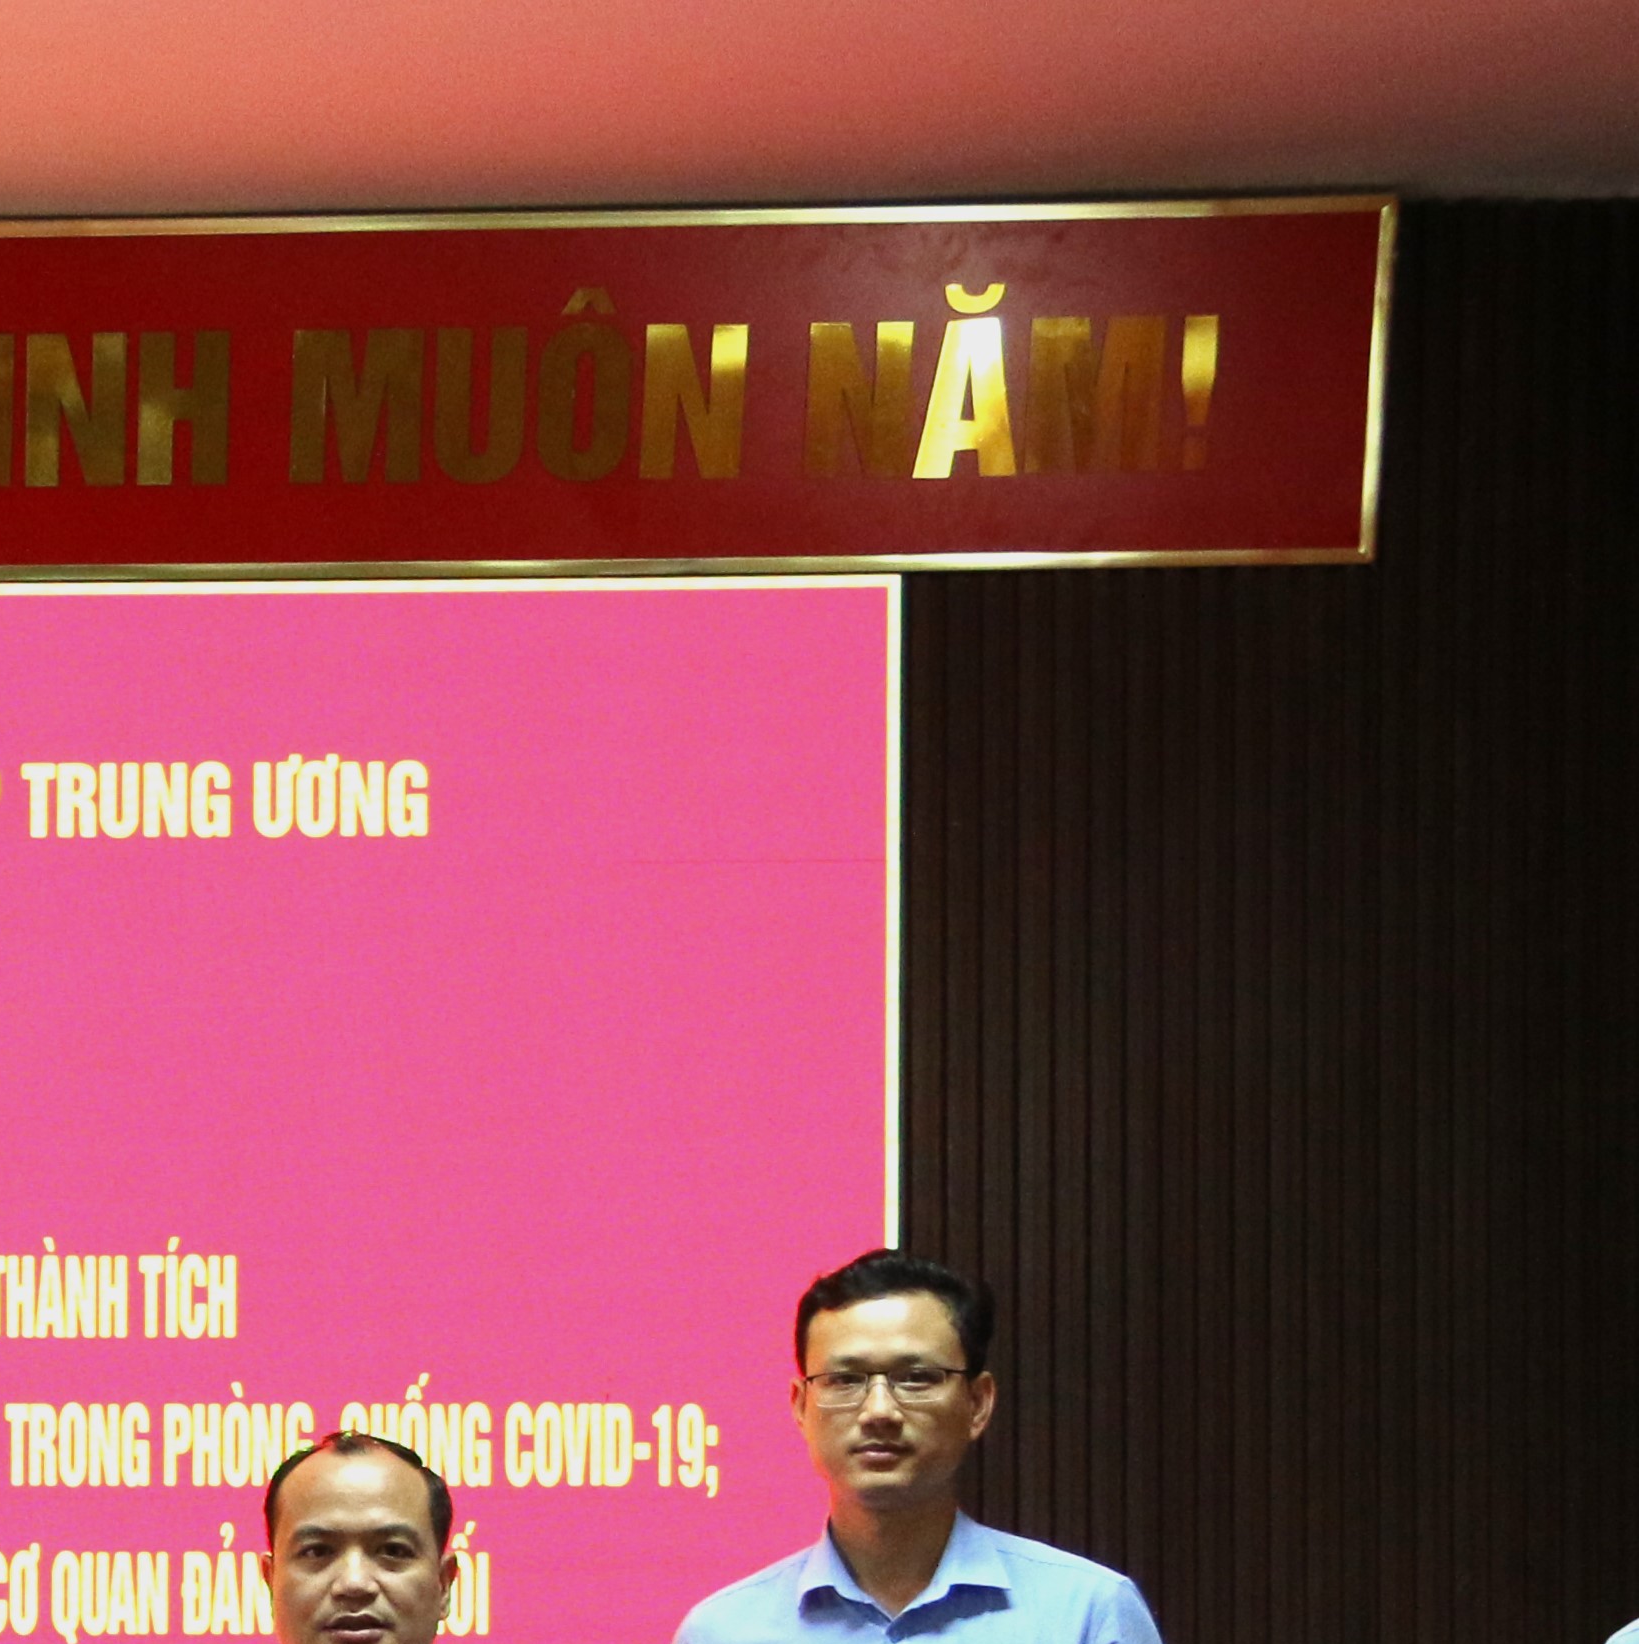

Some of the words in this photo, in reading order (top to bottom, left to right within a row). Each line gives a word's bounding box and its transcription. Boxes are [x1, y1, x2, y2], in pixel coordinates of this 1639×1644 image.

[288, 287, 749, 485] MUÔN
[22, 762, 232, 840] TRUNG
[253, 754, 429, 839] ƯƠNG
[138, 1236, 238, 1339] TÍCH
[5, 1401, 151, 1488] TRONG
[51, 1549, 170, 1644] QUAN
[181, 1522, 275, 1635] ĐẢN
